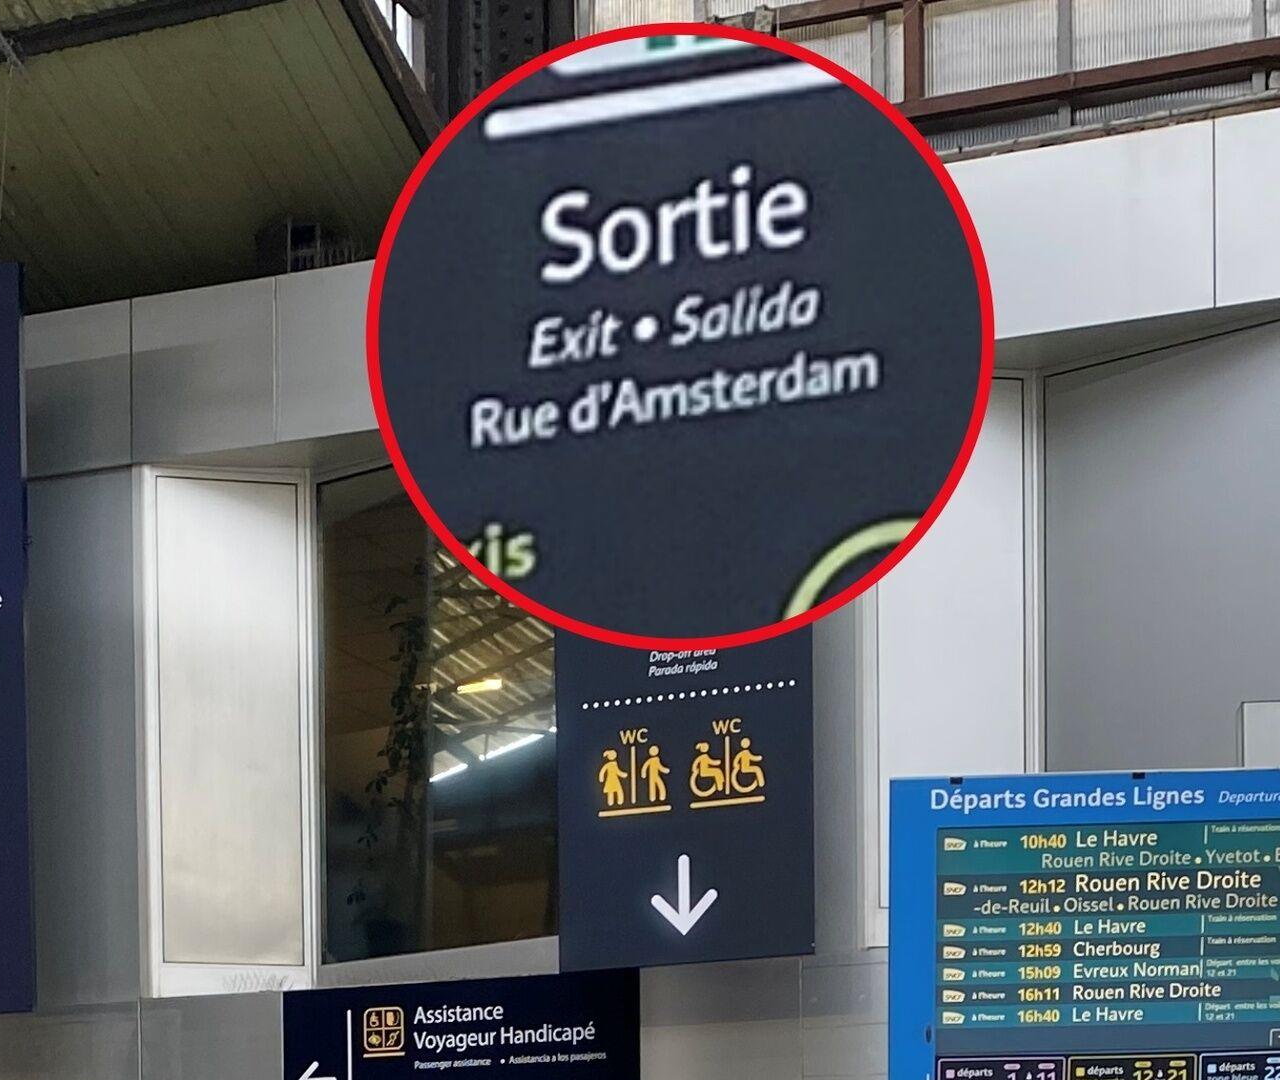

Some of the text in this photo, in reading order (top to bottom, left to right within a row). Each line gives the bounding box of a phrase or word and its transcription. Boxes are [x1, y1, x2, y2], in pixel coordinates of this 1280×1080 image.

[649, 660, 718, 677] Parada rápida
[713, 718, 741, 735] WC
[620, 728, 648, 745] WC
[930, 788, 1026, 814] Départs
[1034, 788, 1125, 809] Grandes
[1134, 786, 1205, 810] Lignes
[1020, 830, 1158, 849] 10h40 Le Havre
[1042, 854, 1093, 869] Rouen
[1099, 852, 1134, 867] Rive
[1140, 851, 1191, 865] Droite
[1205, 849, 1260, 864] Yvetot
[1020, 870, 1261, 894] 12h12 Rouen Rive Droite
[974, 893, 1278, 914] -de-Reuil Oissel Rouen Rive Droite
[1019, 920, 1146, 936] 12h40 Le Havre
[1018, 941, 1161, 959] 12h59 Cherbourg
[1018, 962, 1200, 980] 15h09 Evreux Norman
[1018, 983, 1221, 1001] 16h11 Rouen Rive Droite
[414, 1004, 504, 1024] Assistance
[1017, 1008, 1143, 1023] 16h40 Le Havre
[414, 1022, 596, 1053] Voyageur Handicapé
[957, 1068, 993, 1079] départs
[1087, 1066, 1123, 1076] départs
[1219, 1062, 1255, 1072] départs
